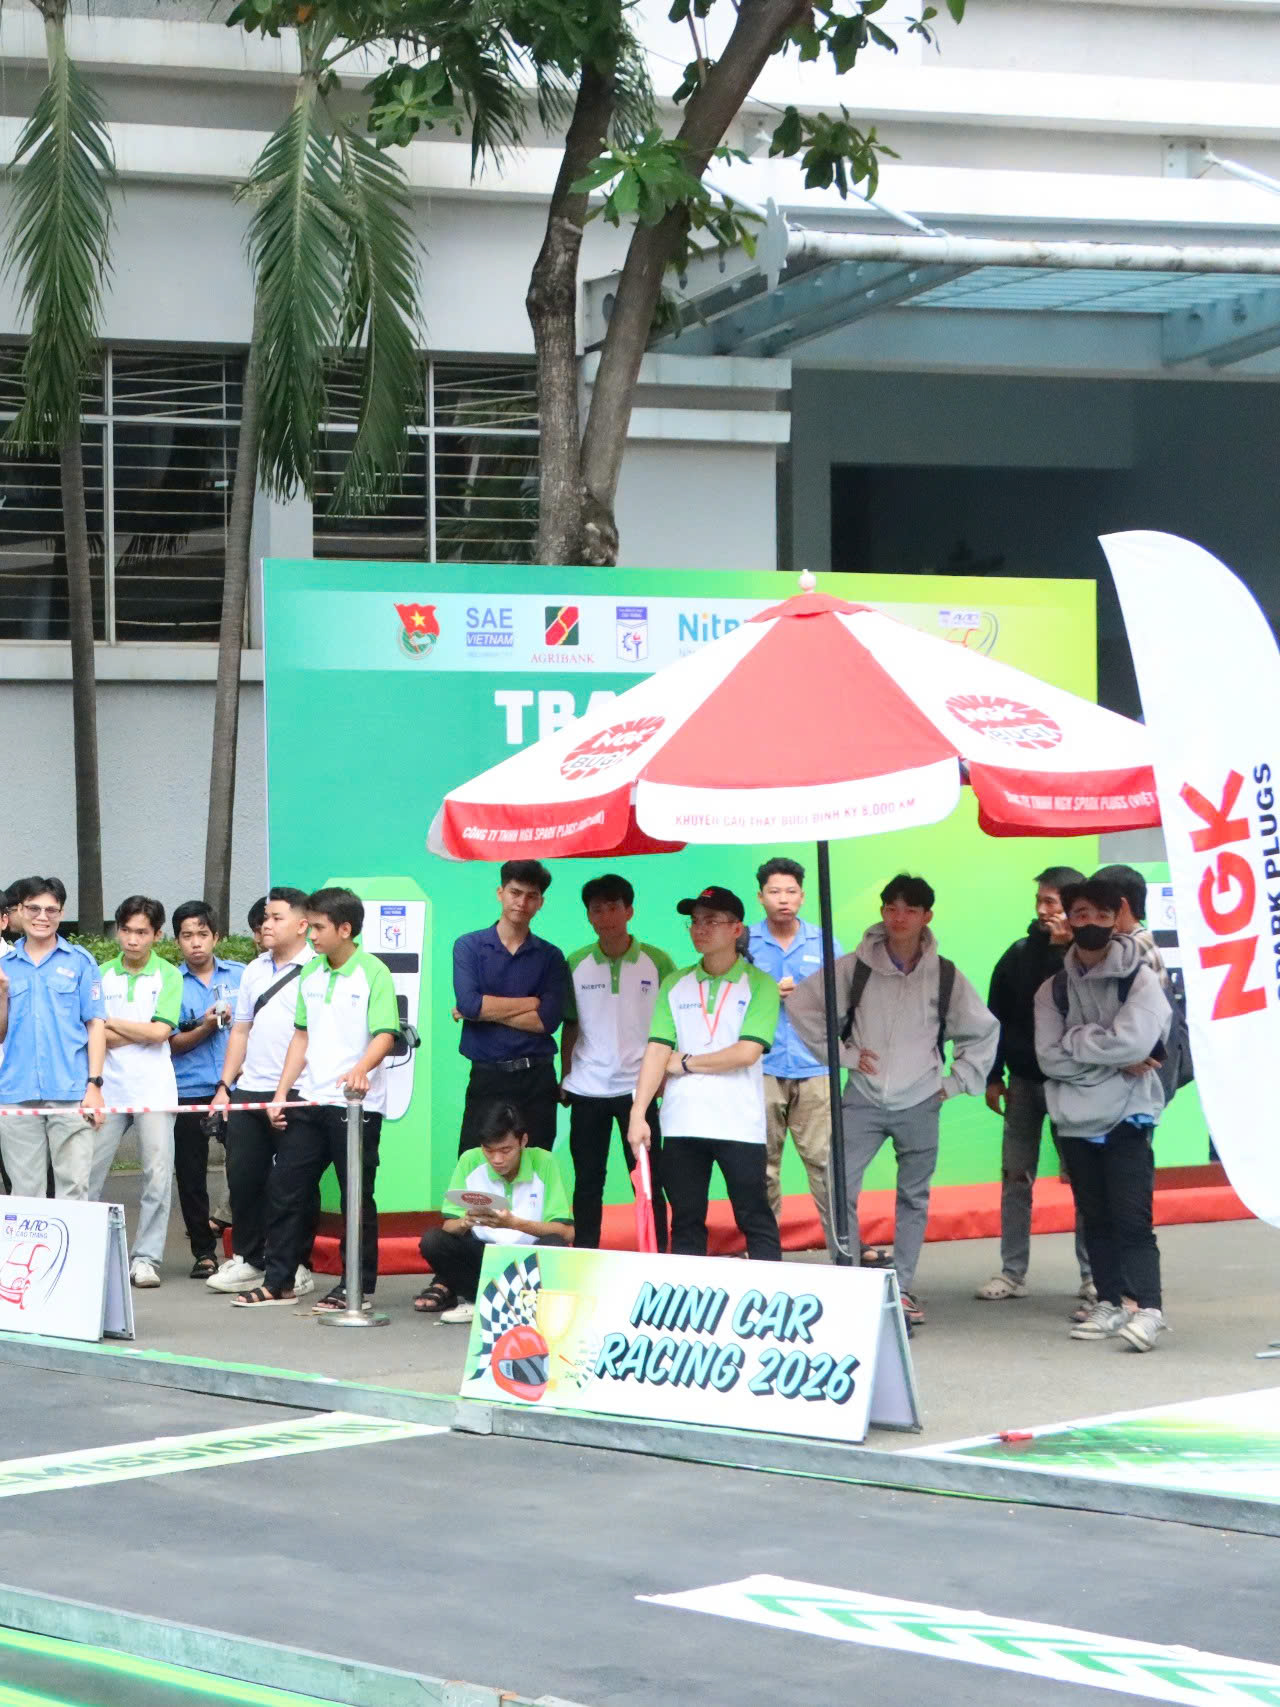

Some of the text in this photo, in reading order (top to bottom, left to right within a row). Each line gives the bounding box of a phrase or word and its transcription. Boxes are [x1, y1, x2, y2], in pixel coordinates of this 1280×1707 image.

[466, 607, 512, 629] SAE
[466, 632, 513, 646] VIETNAM
[530, 653, 595, 664] AGRIBANK
[1253, 763, 1280, 879] PLUGS
[1179, 769, 1267, 1021] NGK
[629, 1281, 823, 1345] MINI CAR
[594, 1332, 861, 1405] RACING 2026
